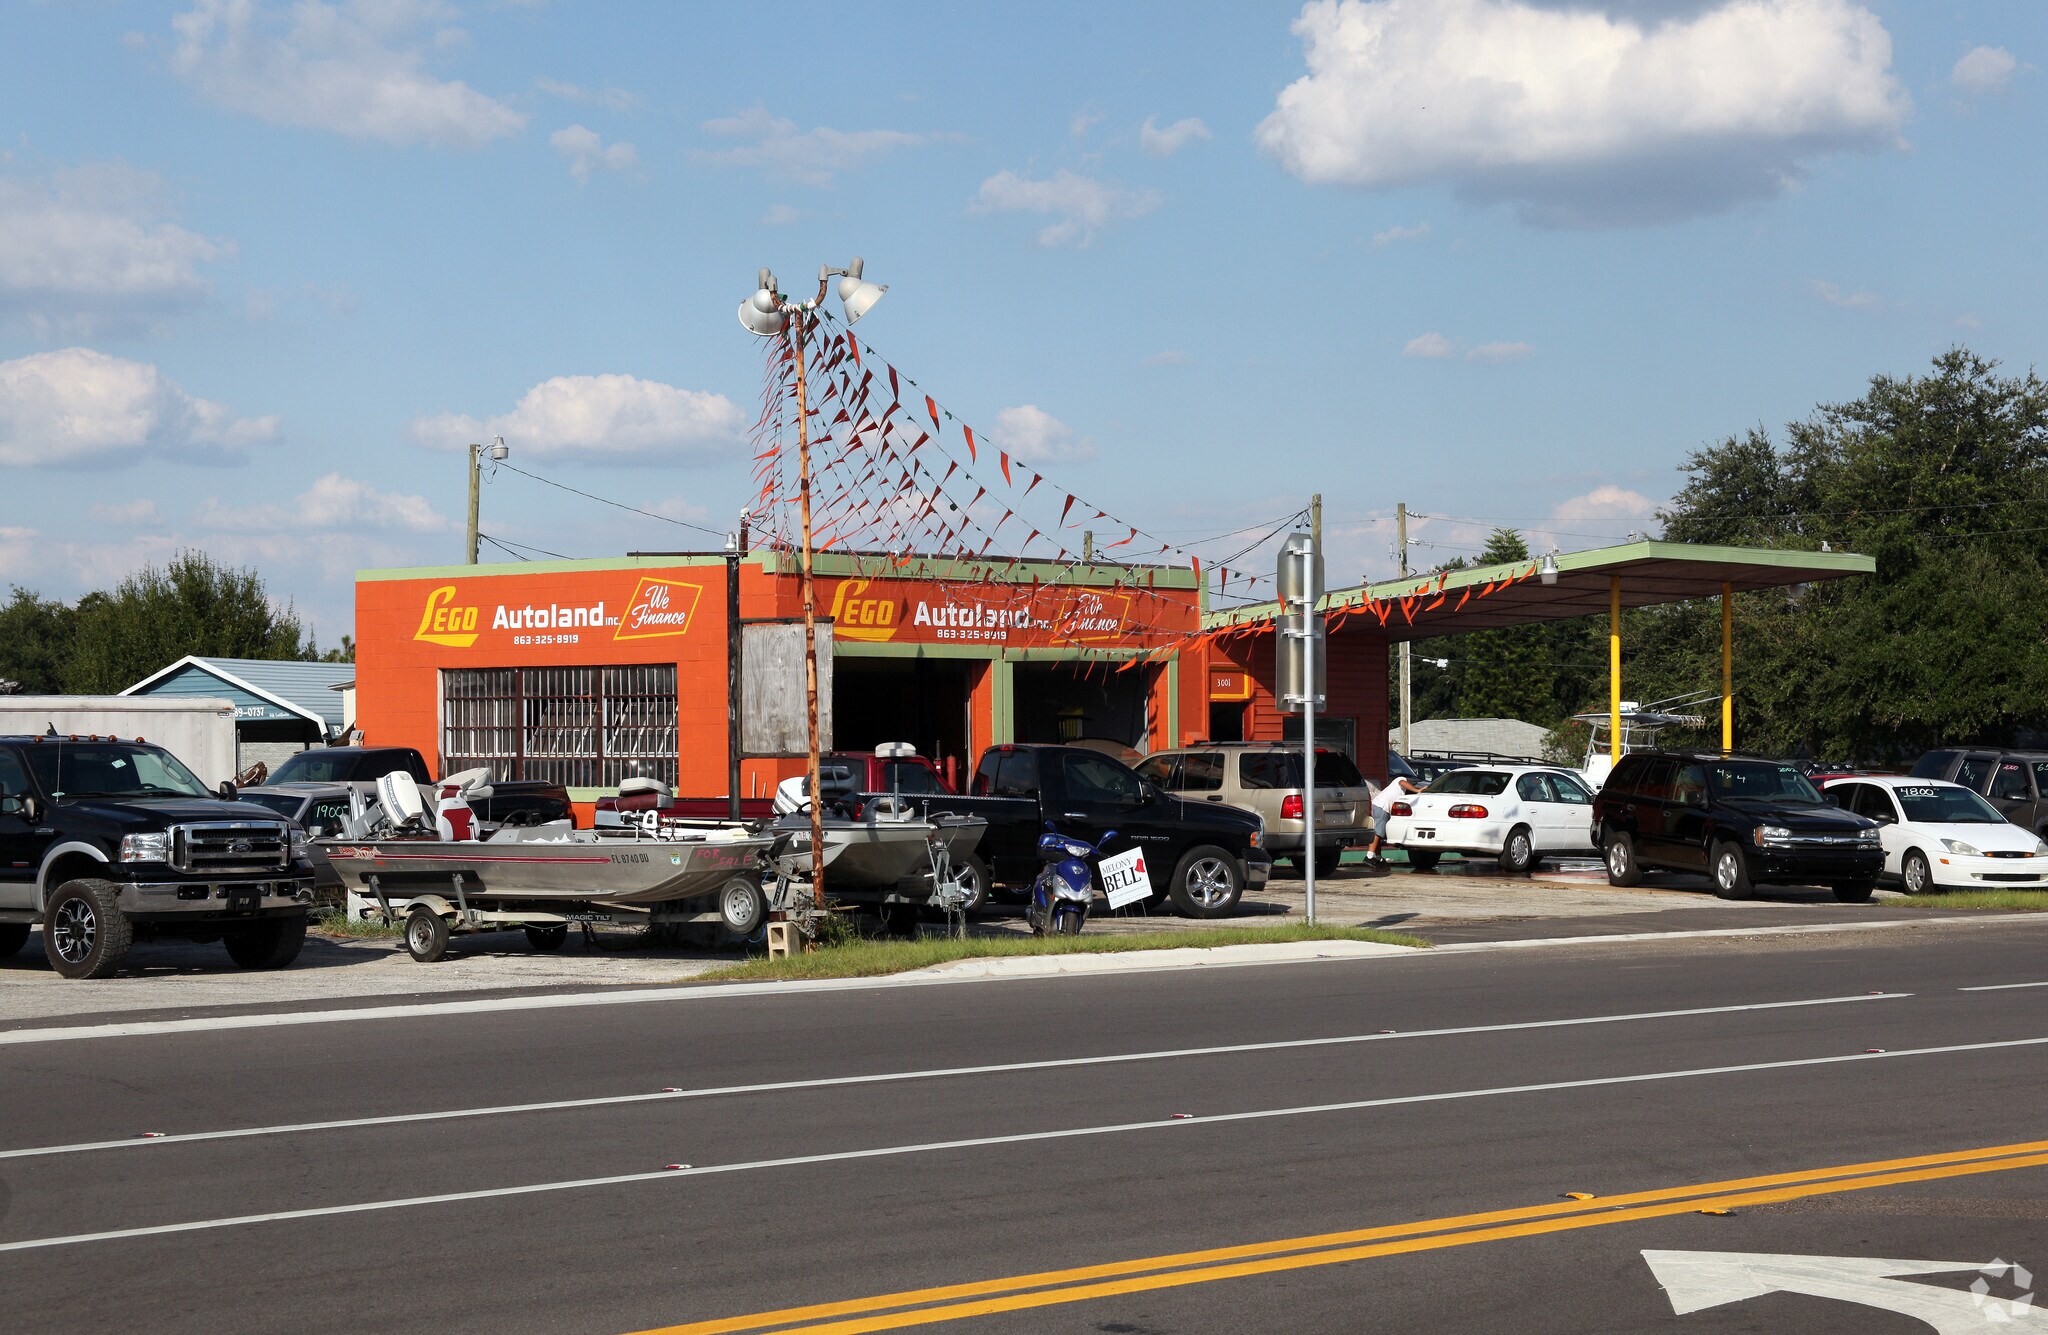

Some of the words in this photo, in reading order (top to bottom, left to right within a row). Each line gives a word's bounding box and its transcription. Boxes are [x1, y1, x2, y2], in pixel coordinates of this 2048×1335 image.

[645, 585, 670, 610] We
[413, 585, 480, 647] LEGO
[492, 601, 604, 629] Autoland
[631, 603, 686, 629] Finance
[913, 601, 1030, 629] Autoland
[513, 634, 579, 645] 863-325-8919
[937, 629, 1007, 640] 863-325-8919
[1217, 678, 1231, 688] 3001
[611, 855, 619, 864] FL
[695, 848, 720, 858] FOR
[718, 854, 753, 866] SALE
[1101, 857, 1132, 875] MELONY
[1103, 867, 1142, 893] BELL
